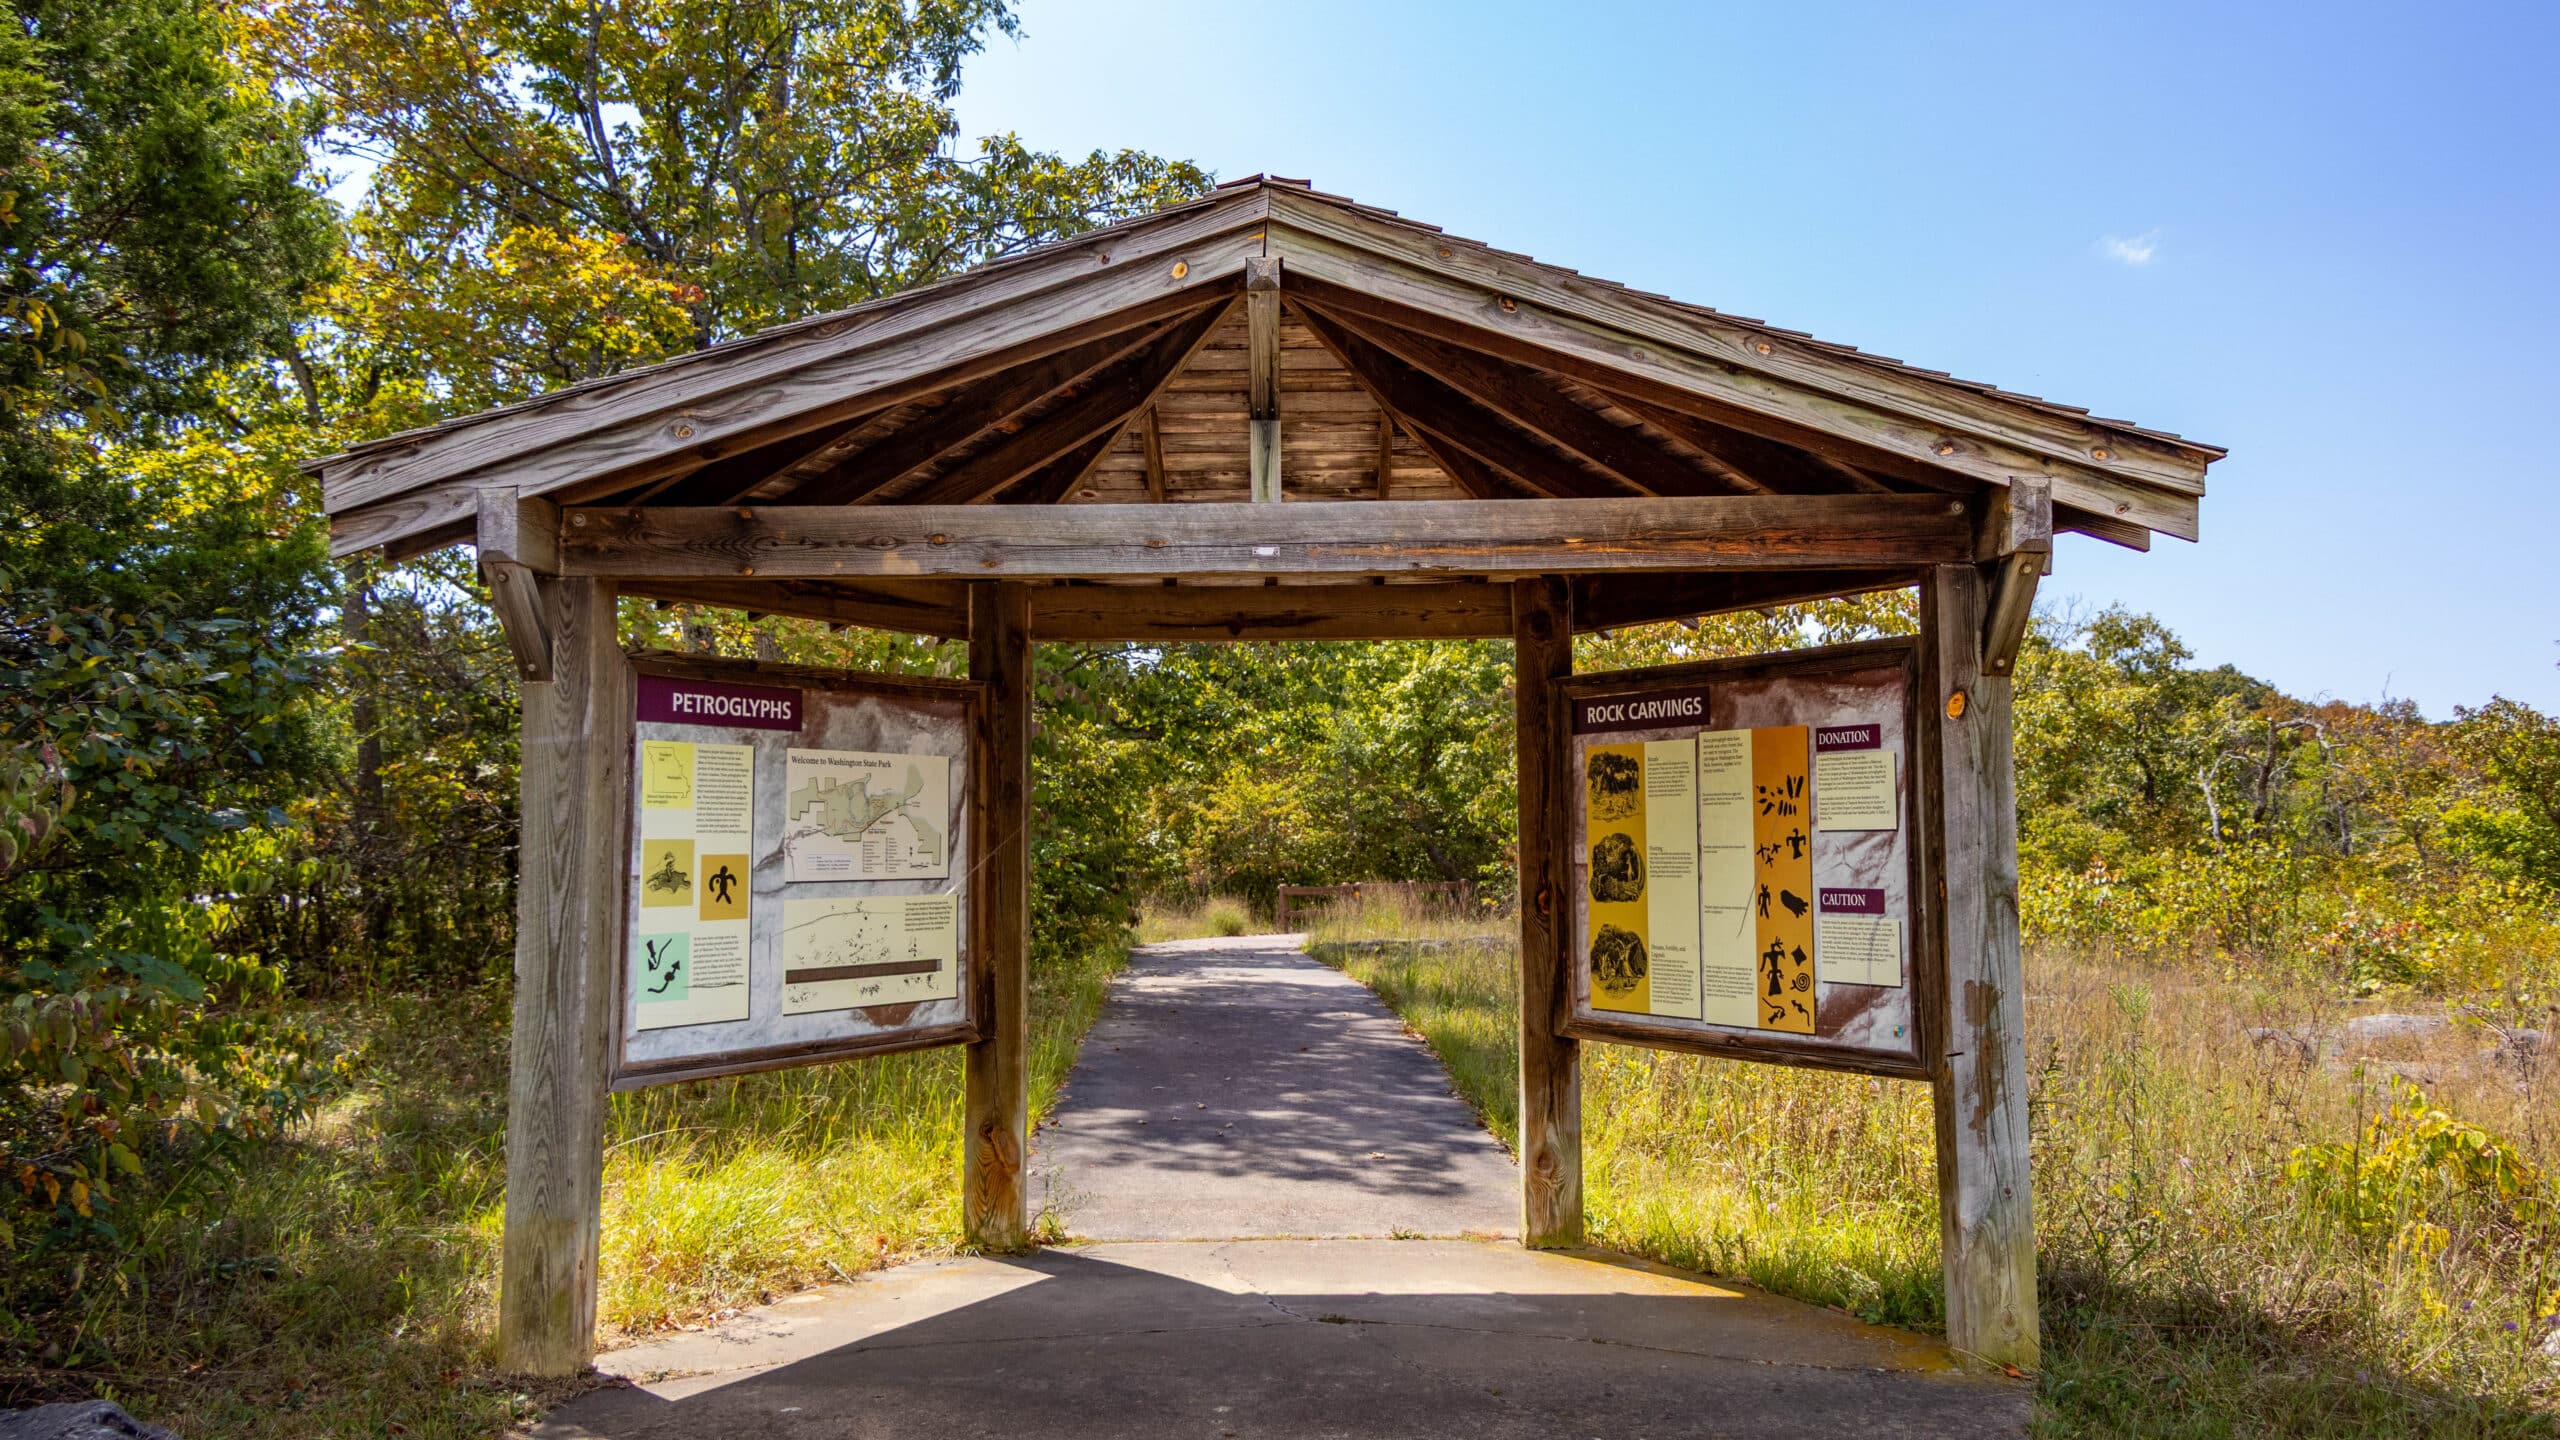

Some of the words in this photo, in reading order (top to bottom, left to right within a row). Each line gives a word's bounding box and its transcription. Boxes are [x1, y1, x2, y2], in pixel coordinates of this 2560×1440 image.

[672, 692, 792, 720] PETROGLYPHS
[1587, 705, 1625, 723] ROCK
[1629, 697, 1702, 720] CARVINGS
[1819, 730, 1870, 745] DONATION
[791, 755, 820, 765] Welcome
[828, 757, 863, 768] Washington
[863, 759, 877, 767] State
[878, 760, 892, 768] Park
[1822, 893, 1866, 906] CAUTION
